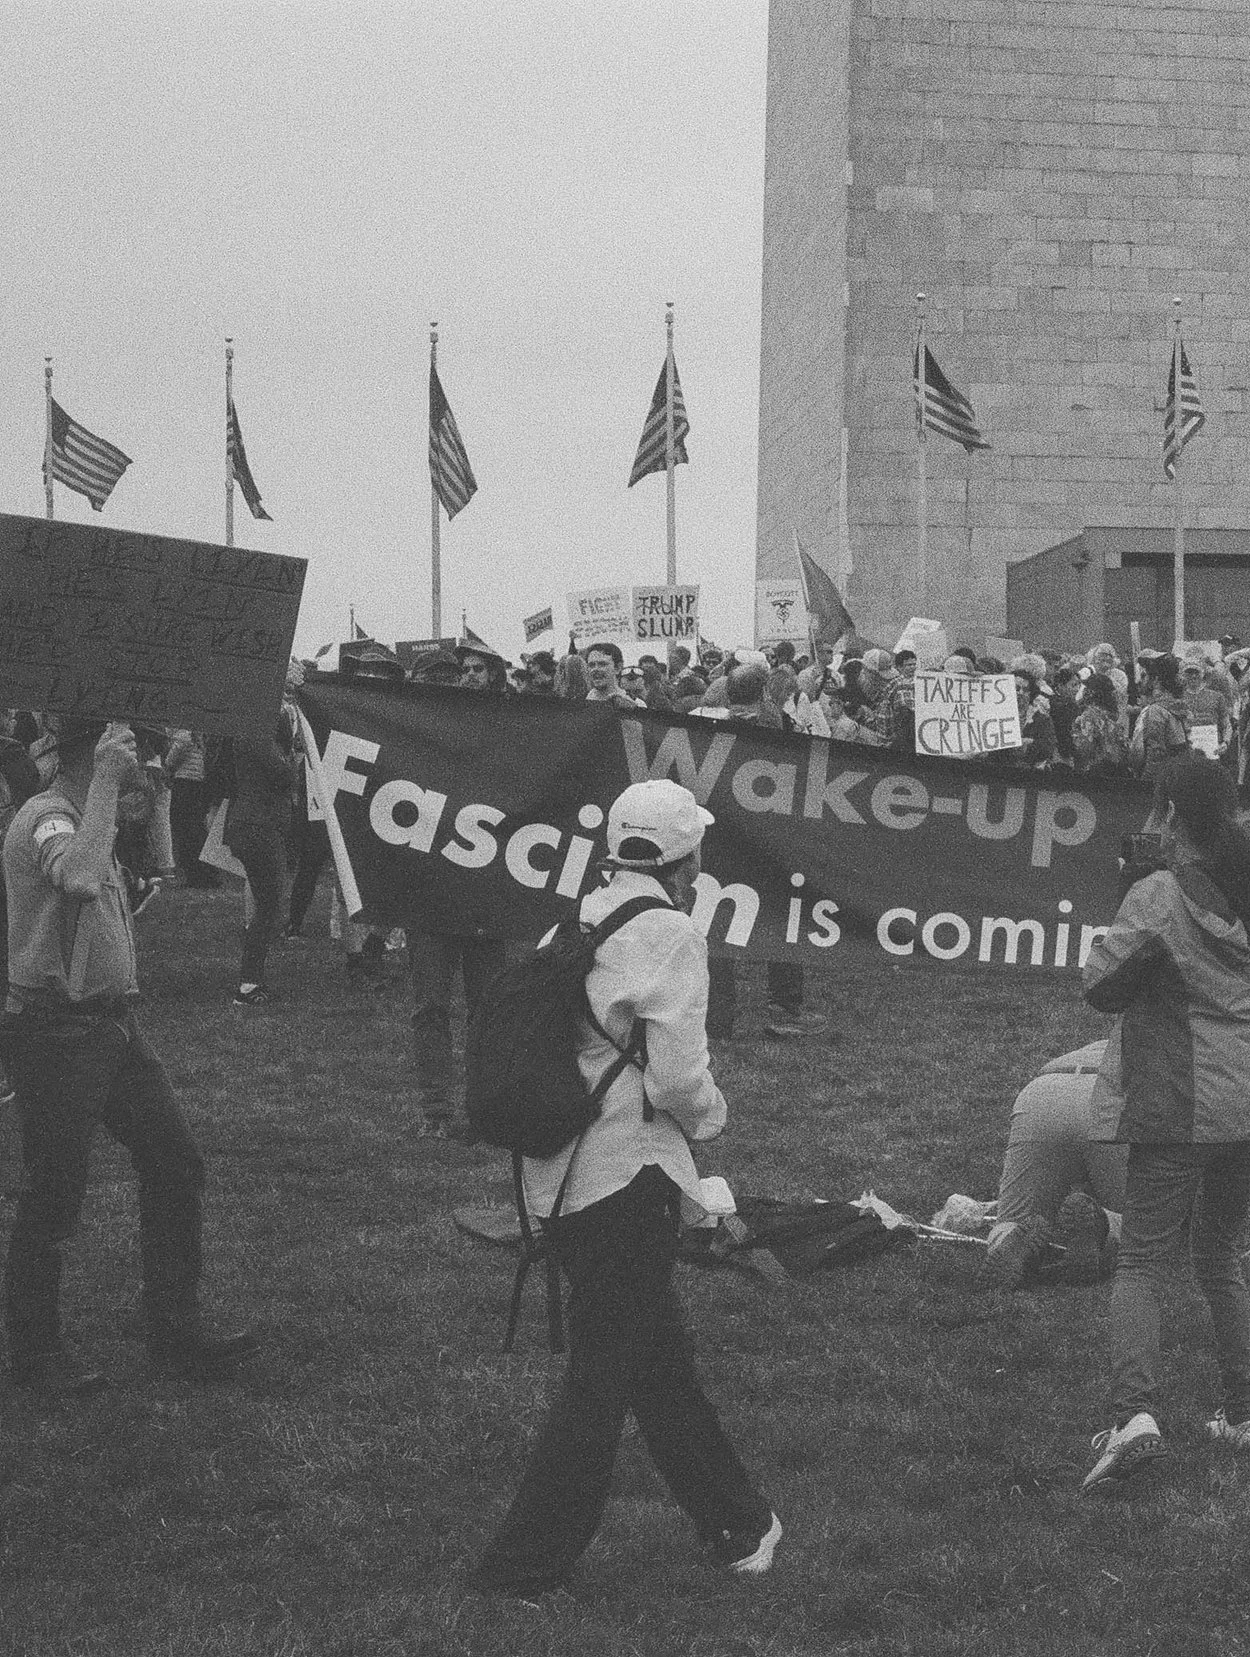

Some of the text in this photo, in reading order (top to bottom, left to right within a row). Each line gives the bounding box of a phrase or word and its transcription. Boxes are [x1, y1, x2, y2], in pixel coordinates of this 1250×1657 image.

[637, 595, 696, 616] TRUMP
[637, 617, 695, 639] SLUMP
[917, 675, 1008, 705] TARIFFS
[951, 703, 975, 722] ARE
[918, 716, 1017, 754] CRINGE
[621, 719, 1097, 868] Wake-up
[316, 729, 761, 947] Fascim
[786, 872, 842, 948] is
